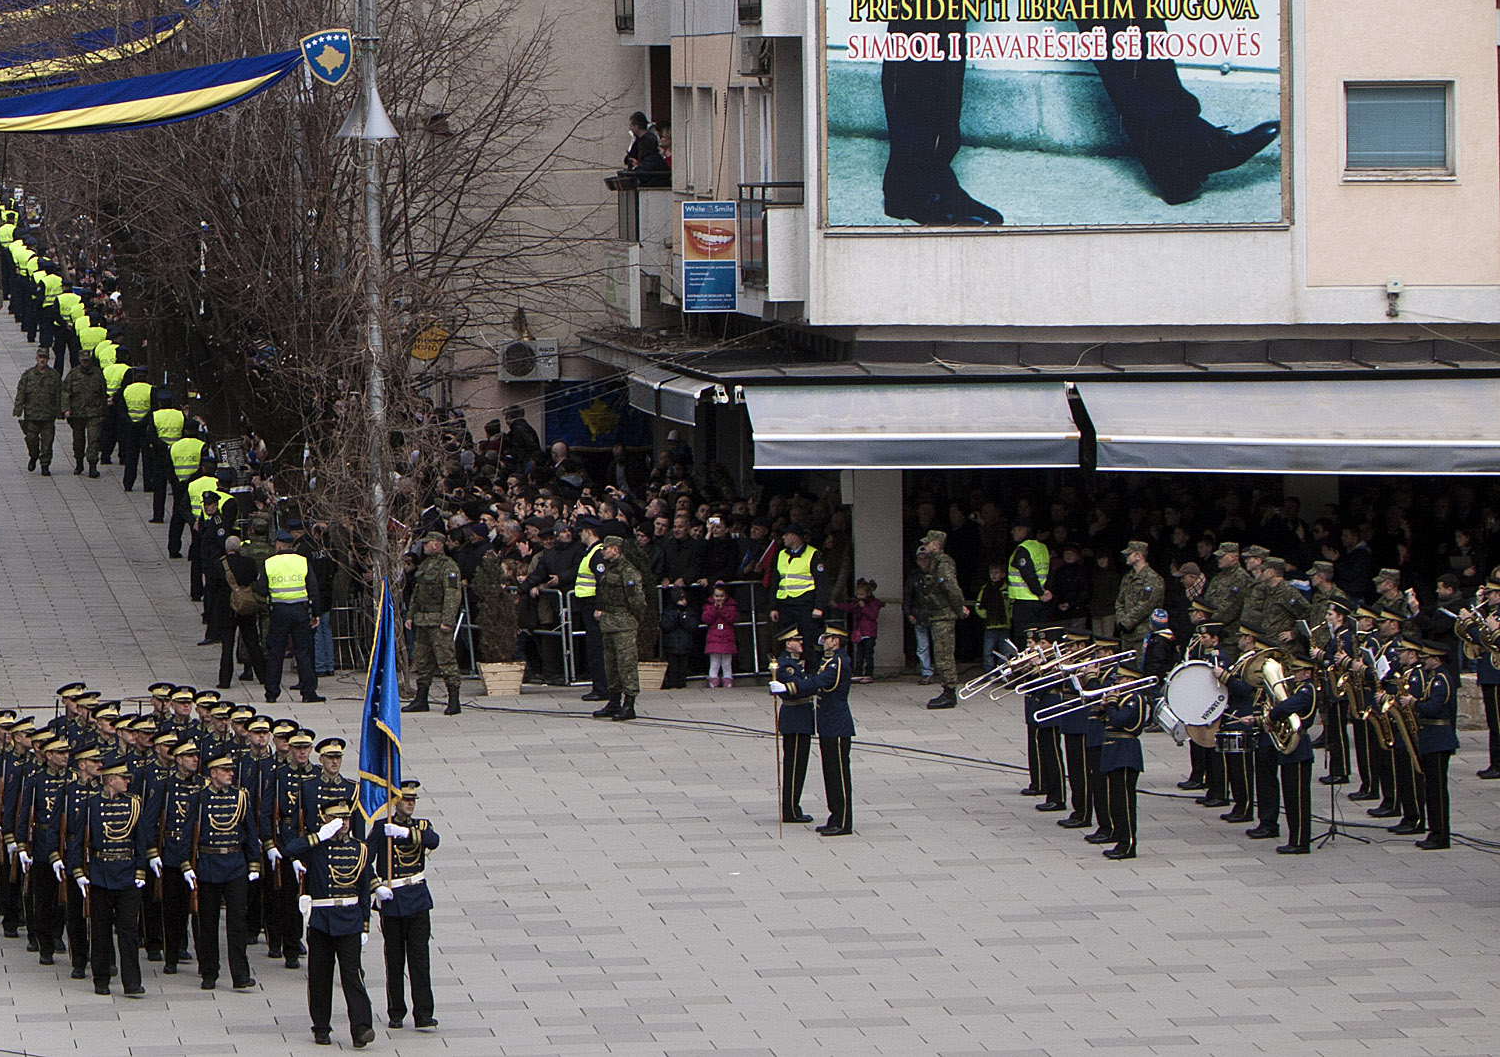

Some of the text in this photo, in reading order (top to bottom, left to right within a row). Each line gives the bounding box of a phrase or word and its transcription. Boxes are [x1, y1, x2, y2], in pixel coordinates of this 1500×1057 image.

[848, 27, 1261, 60] SIMBOL I PAVARËSISË SË KOSOVËS
[685, 205, 706, 213] White
[714, 205, 734, 213] Smile
[174, 455, 198, 463] POLICE
[271, 573, 304, 584] POLICE
[1200, 700, 1221, 720] YAMAHA
